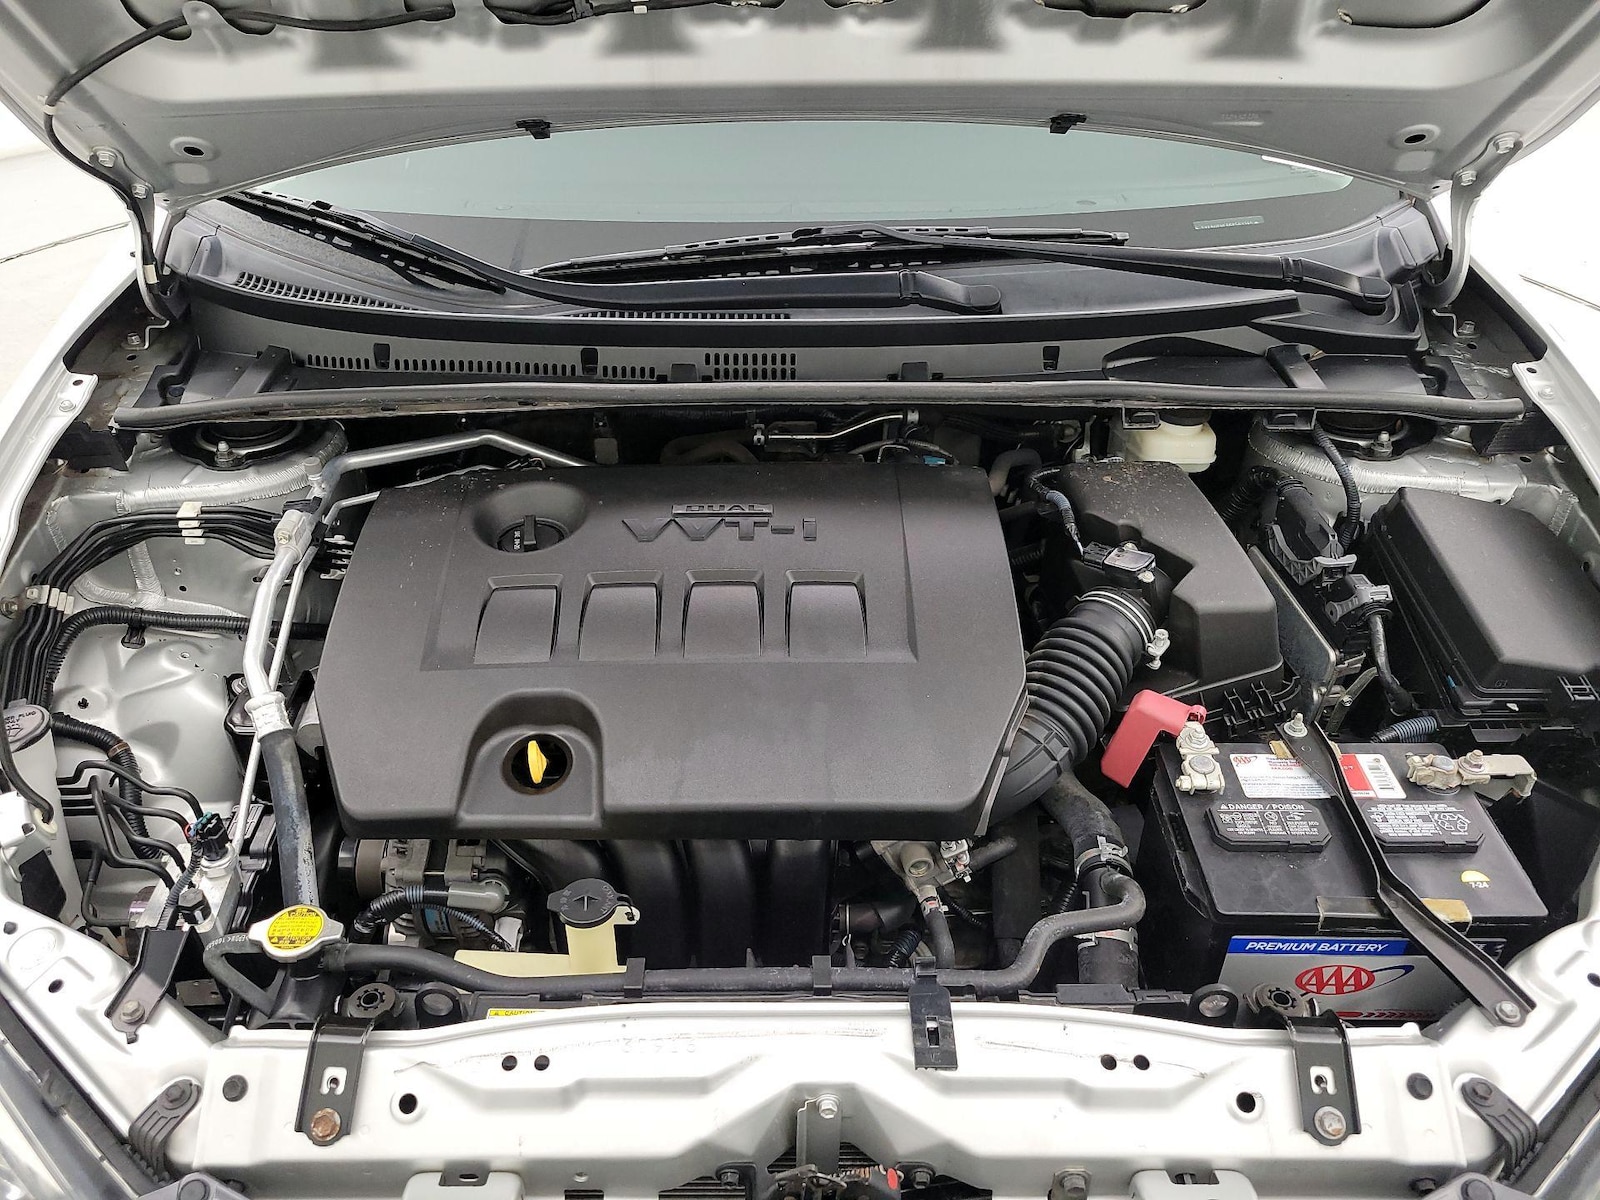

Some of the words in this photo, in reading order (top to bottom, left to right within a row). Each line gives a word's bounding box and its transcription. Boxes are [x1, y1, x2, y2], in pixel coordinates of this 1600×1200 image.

[680, 504, 768, 514] DUAL
[1245, 941, 1317, 951] PREMIUM
[1317, 942, 1389, 952] BATTERY
[1299, 965, 1369, 995] AAA
